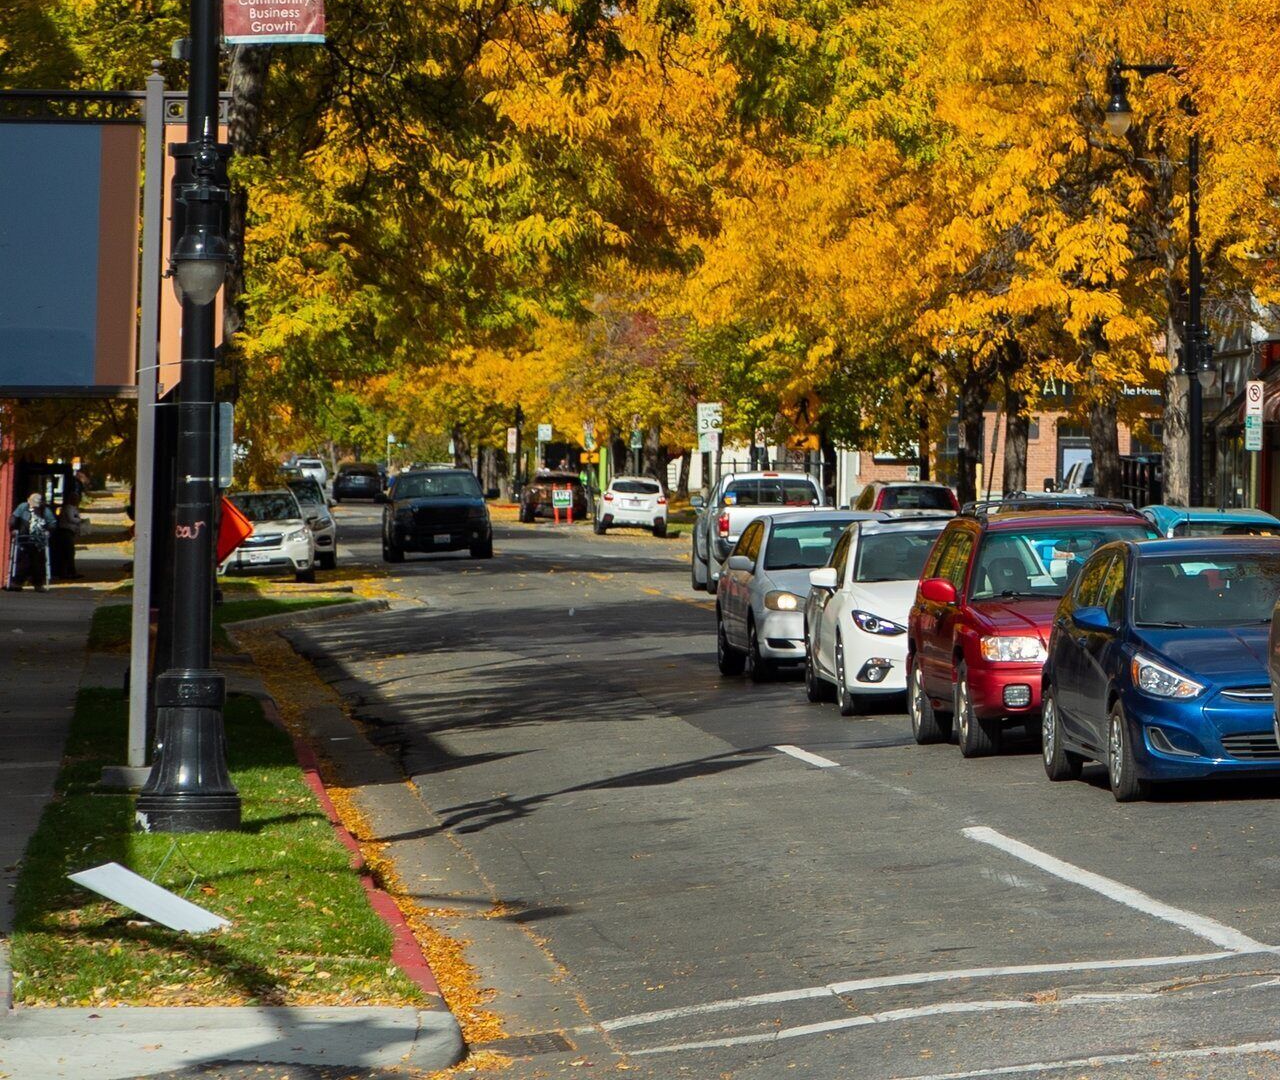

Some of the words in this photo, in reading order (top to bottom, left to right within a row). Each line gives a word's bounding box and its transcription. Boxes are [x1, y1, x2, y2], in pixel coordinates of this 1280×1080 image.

[249, 7, 300, 19] Business
[251, 21, 298, 32] Growth
[701, 418, 720, 430] 30
